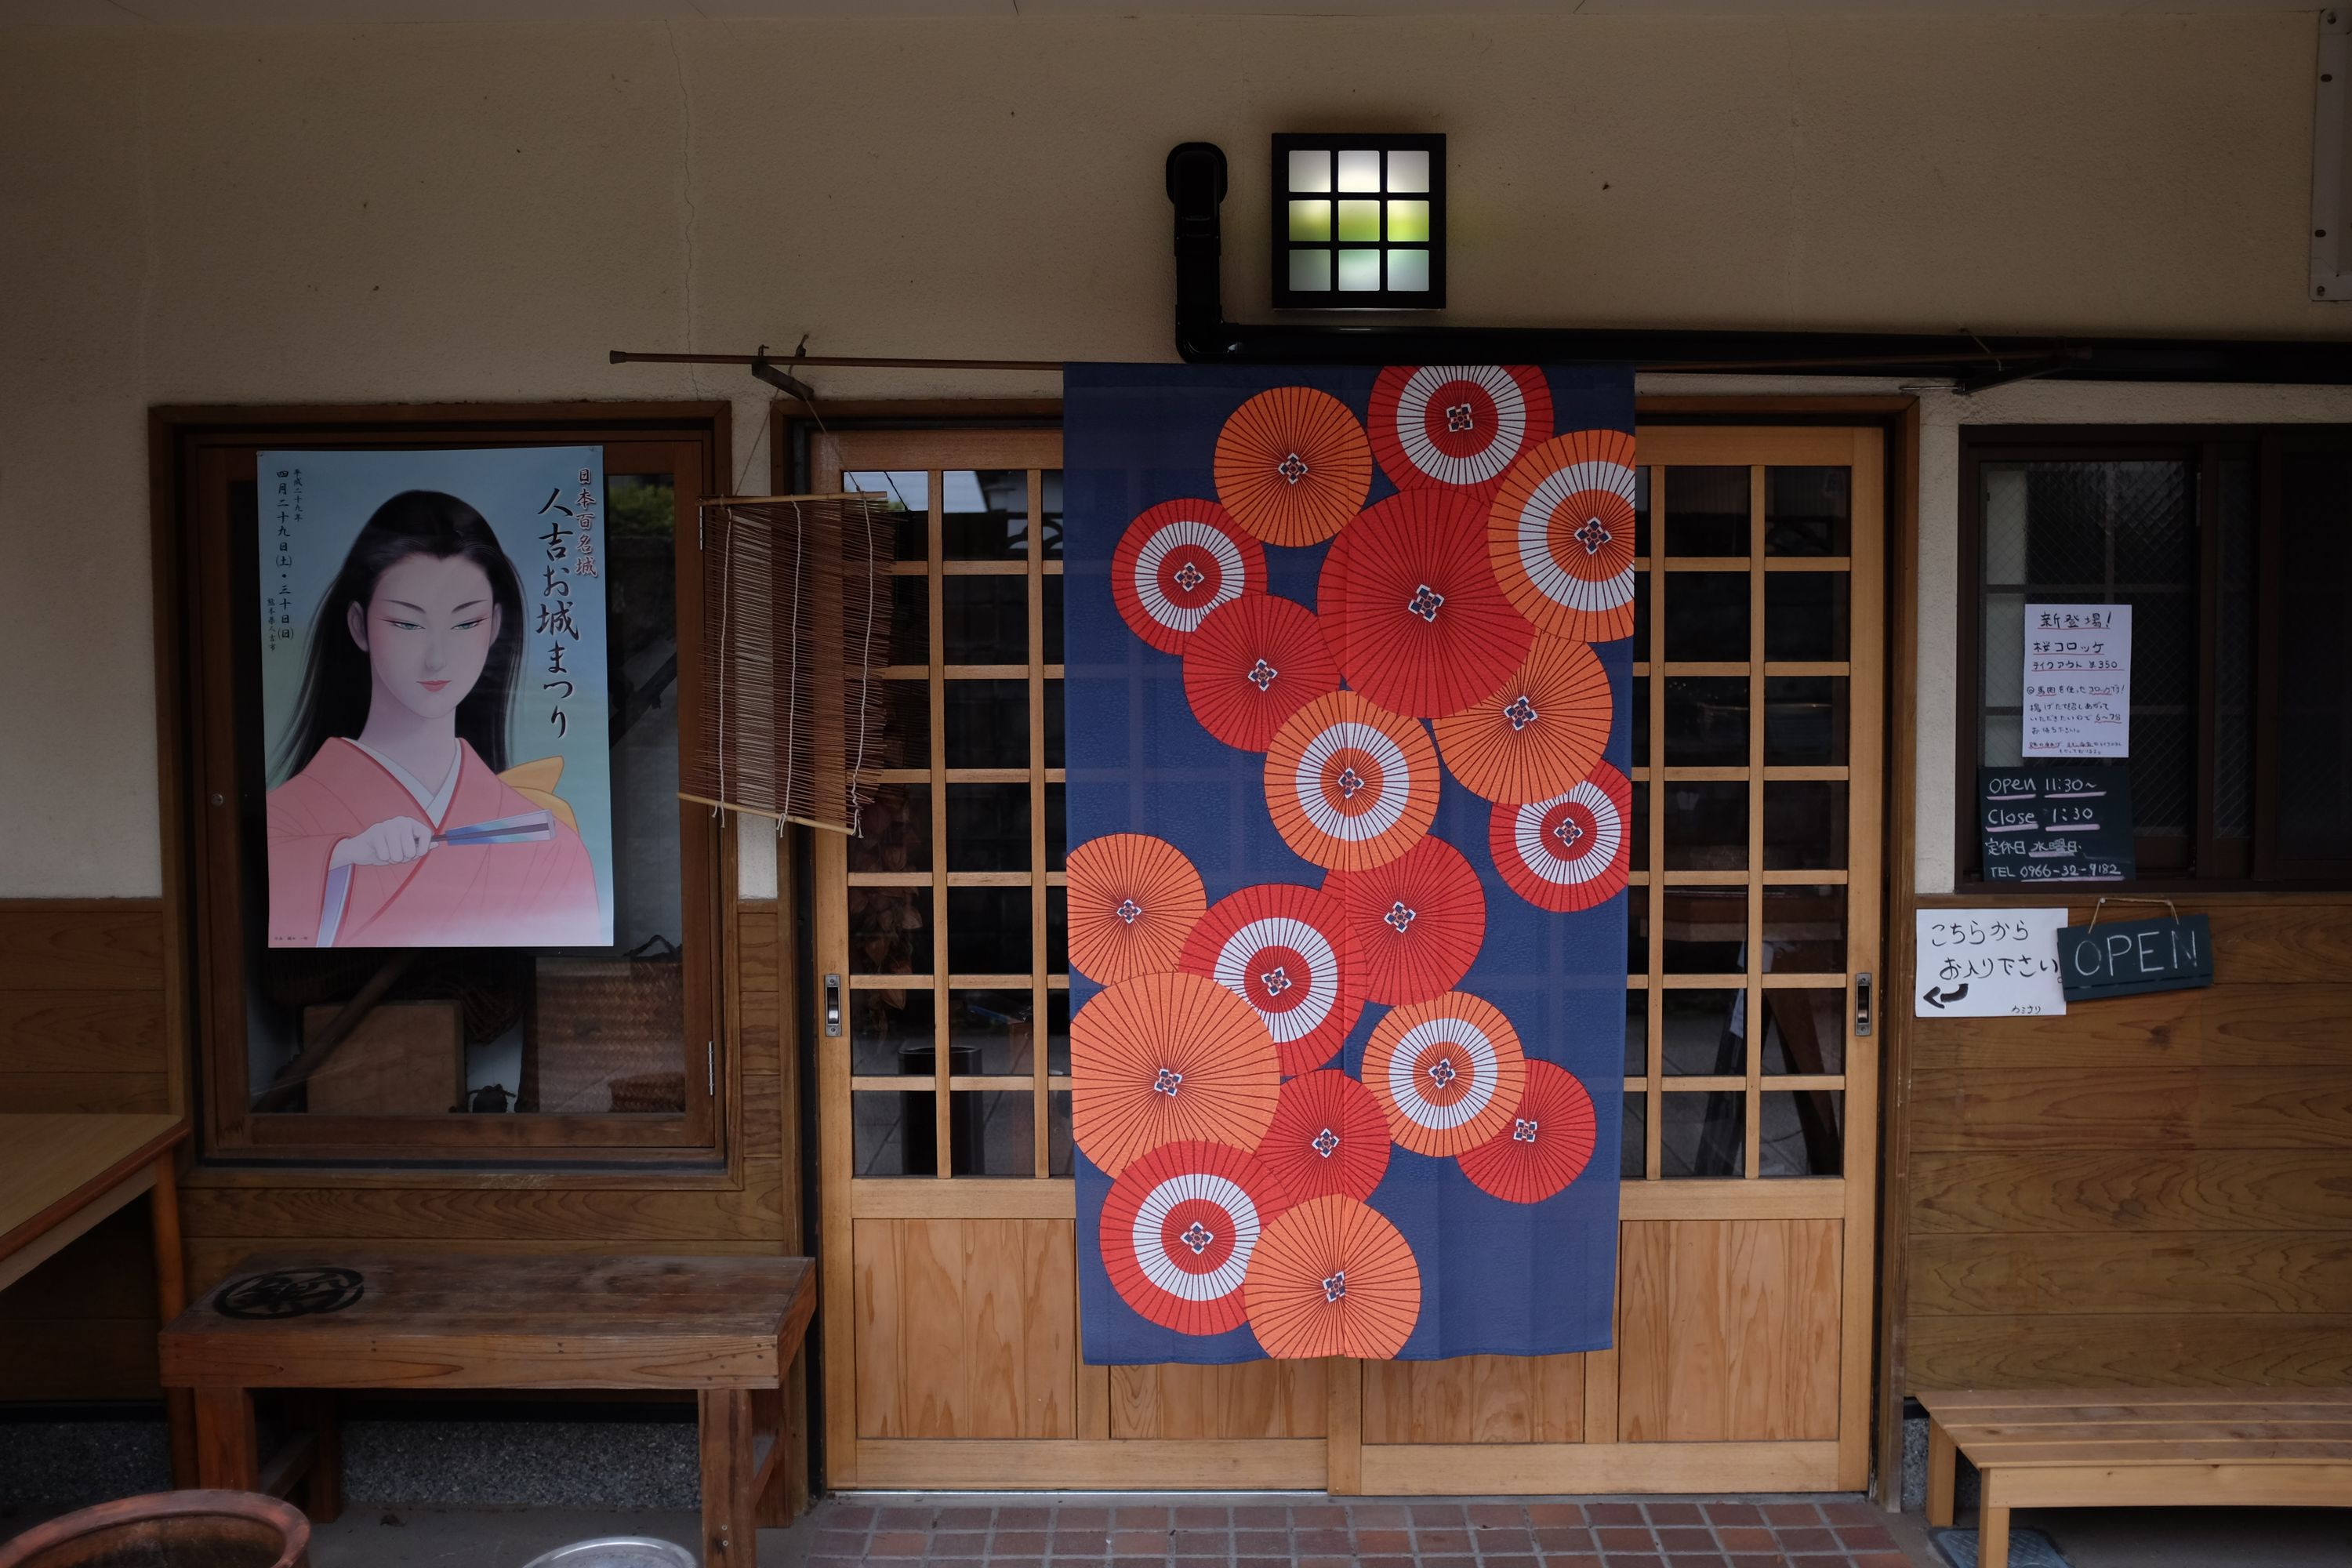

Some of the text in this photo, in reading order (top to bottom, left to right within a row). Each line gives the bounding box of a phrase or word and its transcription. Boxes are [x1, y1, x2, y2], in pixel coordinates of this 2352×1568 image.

[293, 469, 303, 523] 平成二十九年
[575, 468, 598, 579] 日本百名城
[536, 488, 580, 739] 人吉お城まつり
[2040, 611, 2111, 629] 新登場!
[2032, 641, 2105, 654] 桜コロッケ
[2032, 660, 2118, 670] テイクアウト ¥350
[1987, 808, 2093, 825] Close 1:30
[1985, 837, 2027, 856] 定休日
[1991, 863, 2122, 878] TEL 0966-32-9182
[1931, 920, 2030, 947] こちらから
[2074, 930, 2198, 977] OPEN
